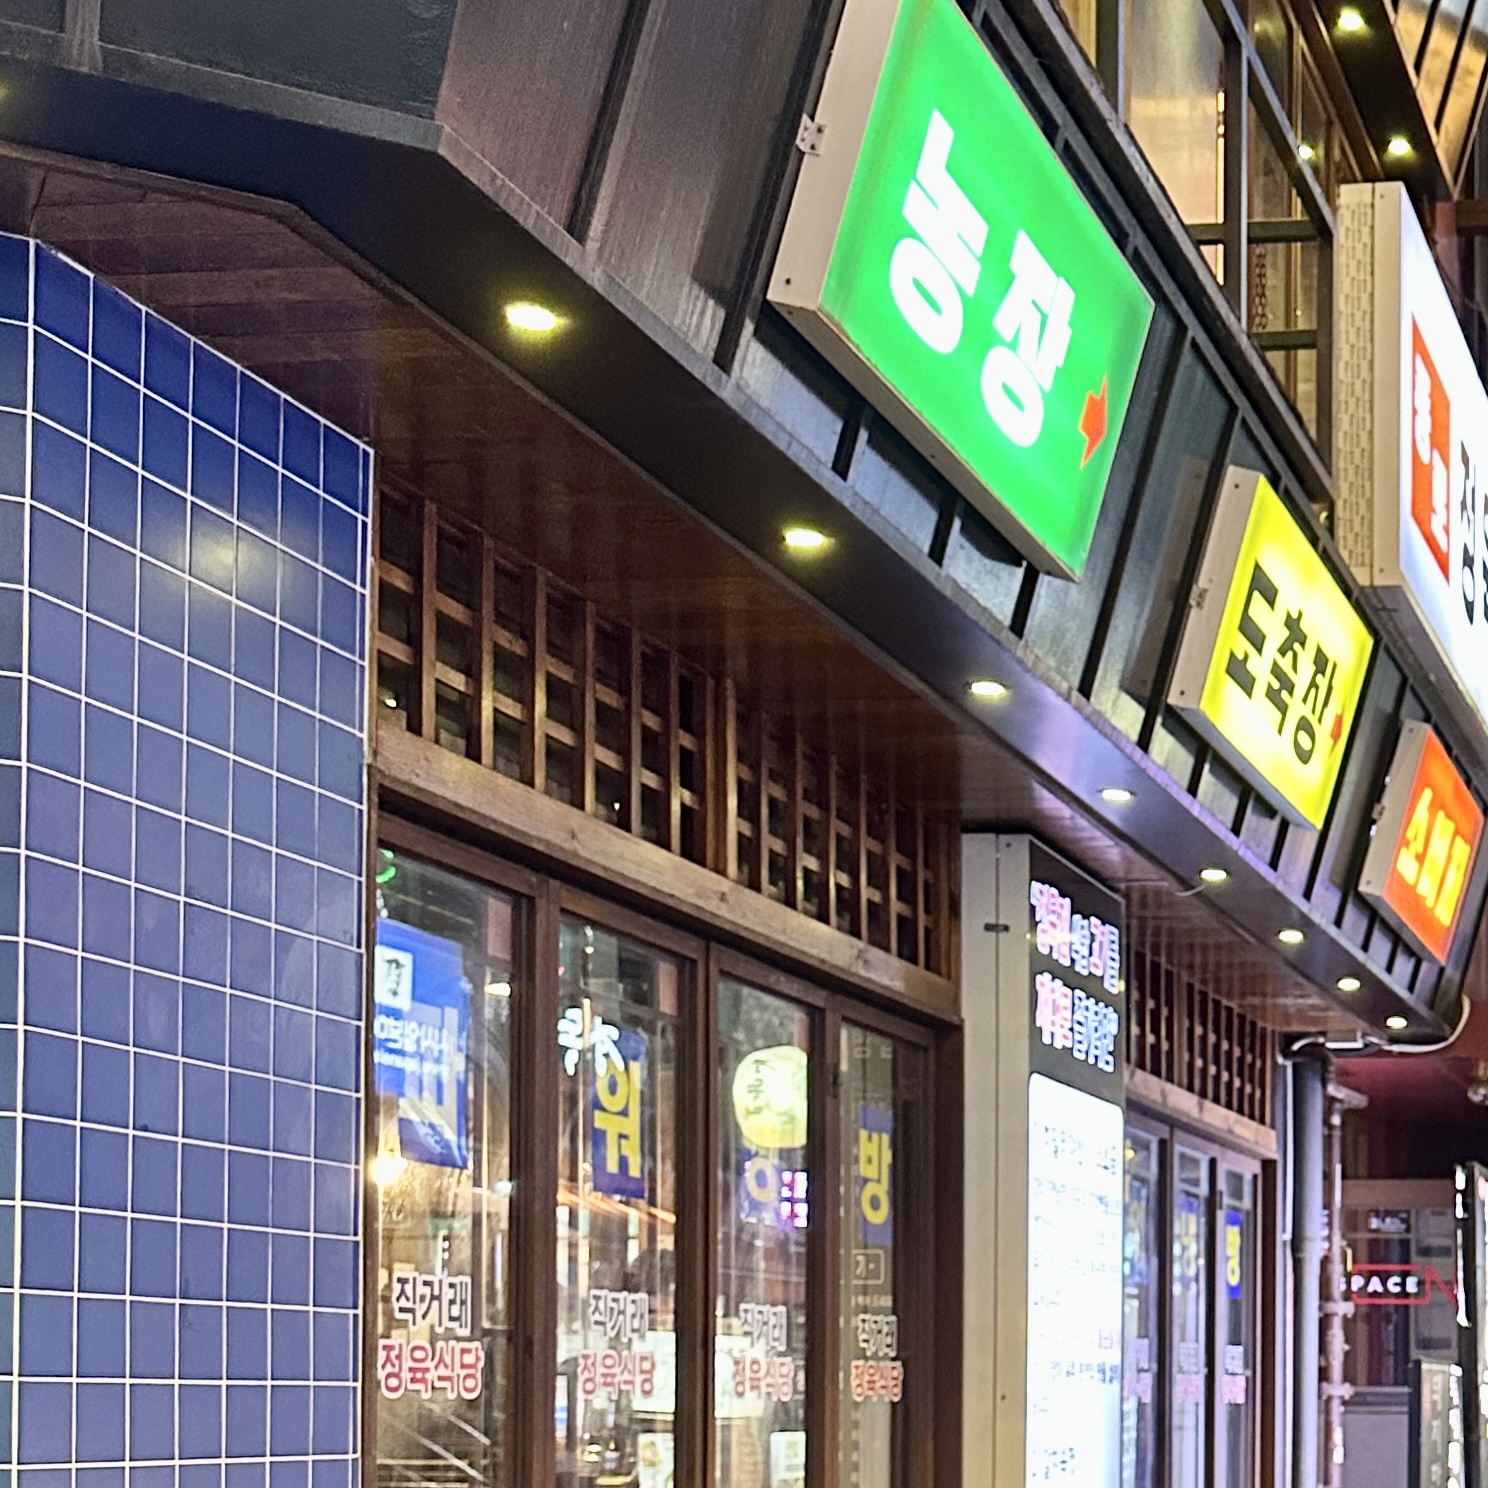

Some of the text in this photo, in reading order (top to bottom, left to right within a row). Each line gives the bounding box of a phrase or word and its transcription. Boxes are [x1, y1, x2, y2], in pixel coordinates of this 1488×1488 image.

[889, 107, 1076, 448] 농장
[1226, 558, 1338, 765] 도축장
[394, 1274, 470, 1333] 직거래
[590, 1291, 648, 1340] 직거래
[379, 1340, 484, 1398] 정육식당
[579, 1350, 656, 1398] 정육식당
